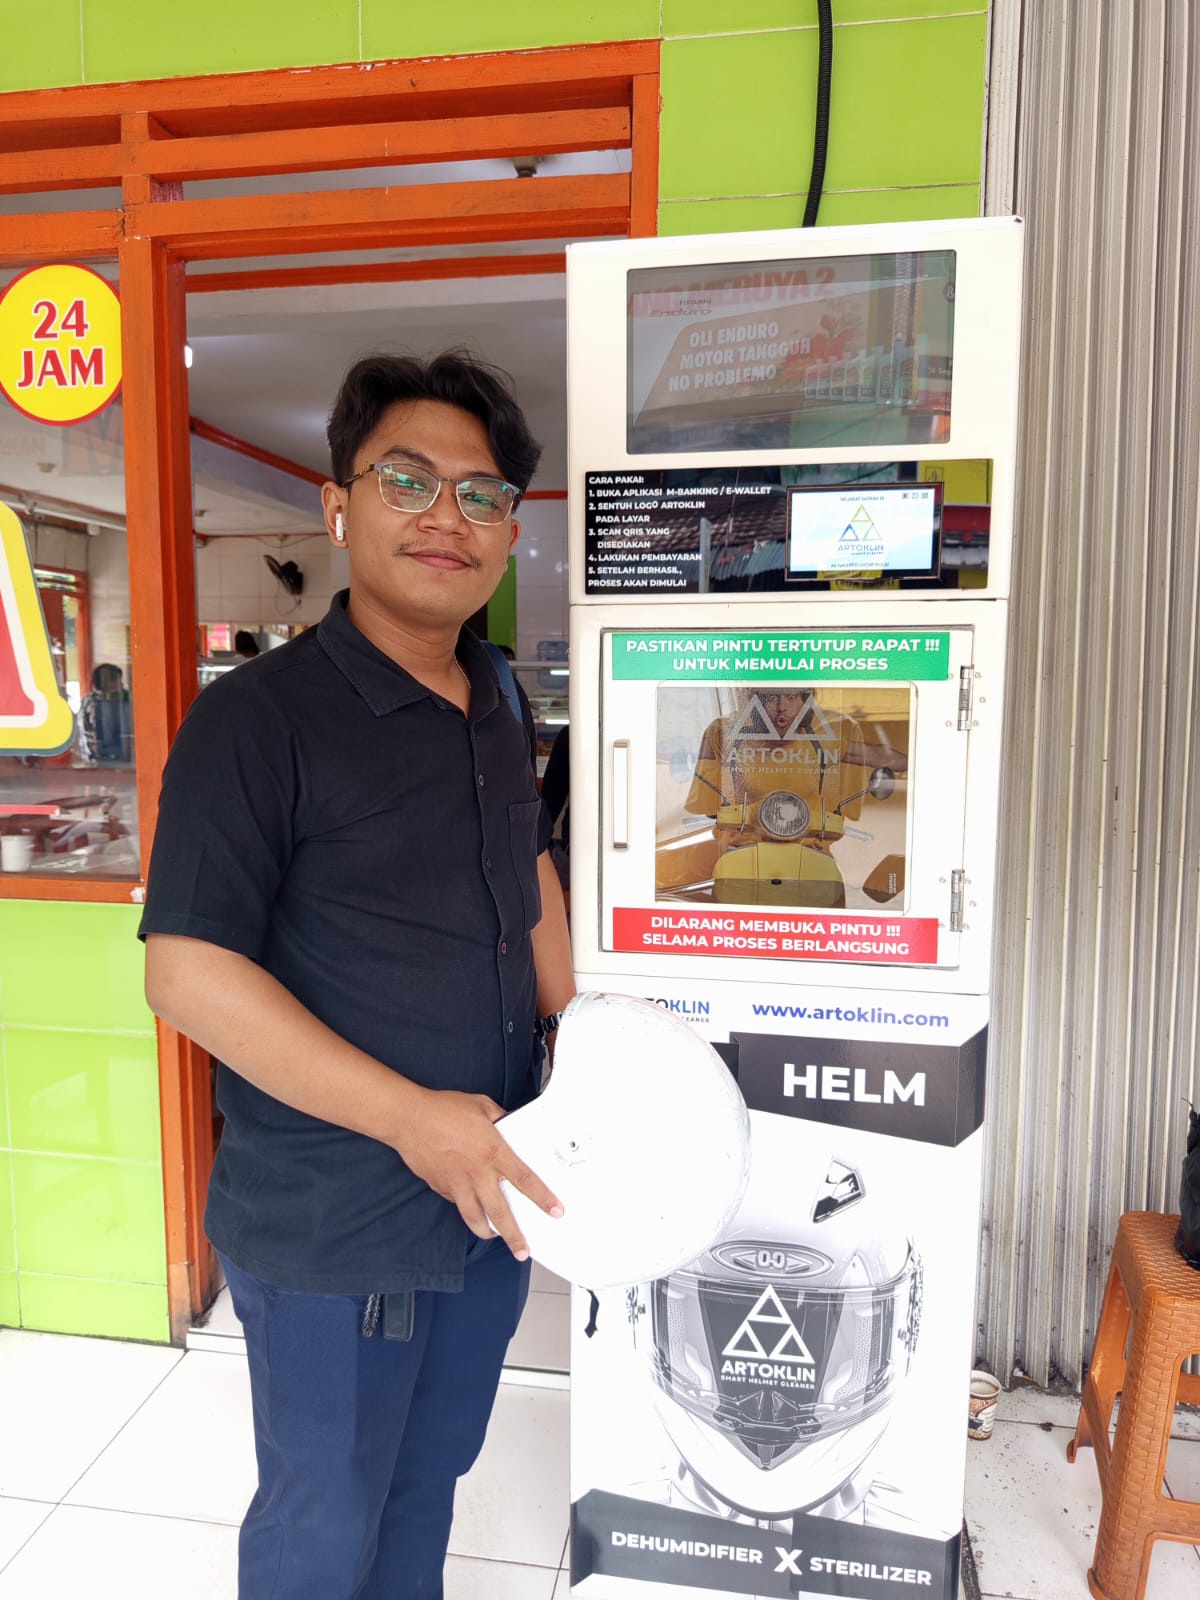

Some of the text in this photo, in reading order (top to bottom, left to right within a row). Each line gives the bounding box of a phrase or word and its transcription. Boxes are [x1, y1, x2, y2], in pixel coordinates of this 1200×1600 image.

[33, 300, 89, 339] 24
[689, 322, 779, 348] OLI ENDURO
[680, 337, 812, 370] MOTOR TANGGUH
[17, 348, 104, 388] JAM
[668, 364, 777, 393] NO PROBLEMO
[623, 489, 662, 497] APLIKASI
[666, 488, 718, 496] M-BANKING
[720, 486, 724, 496] /
[726, 487, 772, 495] E-WALLET
[598, 502, 632, 510] SENTUH
[634, 501, 658, 509] LOGO
[661, 501, 705, 509] ARTOKLIN
[596, 515, 650, 523] PADA LAYAR
[597, 528, 621, 536] SCAN
[623, 528, 644, 536] QRIS
[597, 541, 650, 549] DISEDIAKAN
[588, 554, 597, 562] 4.
[598, 554, 642, 562] LAKUKAN
[588, 579, 687, 587] PROSES AKAN DIMULAI
[626, 638, 940, 653] PASTIKAN PINTU TERTUTUP RAPAT !!!
[673, 657, 888, 671] UNTUK MEMULAI PROSES
[727, 747, 840, 765] ARTOKLIN
[651, 916, 901, 937] DILARANG MEMBUKA PINTU !!!
[643, 933, 909, 956] SELAMA PROSES BERLANGSUNG
[752, 1002, 949, 1027] www.artoklin.com
[783, 1063, 926, 1107] HELM
[721, 1360, 815, 1383] ARTOKLIN
[720, 1375, 815, 1390] SMART HELMET CLEANER
[611, 1531, 932, 1586] DEHUMIDIFIER X STERILIZER
